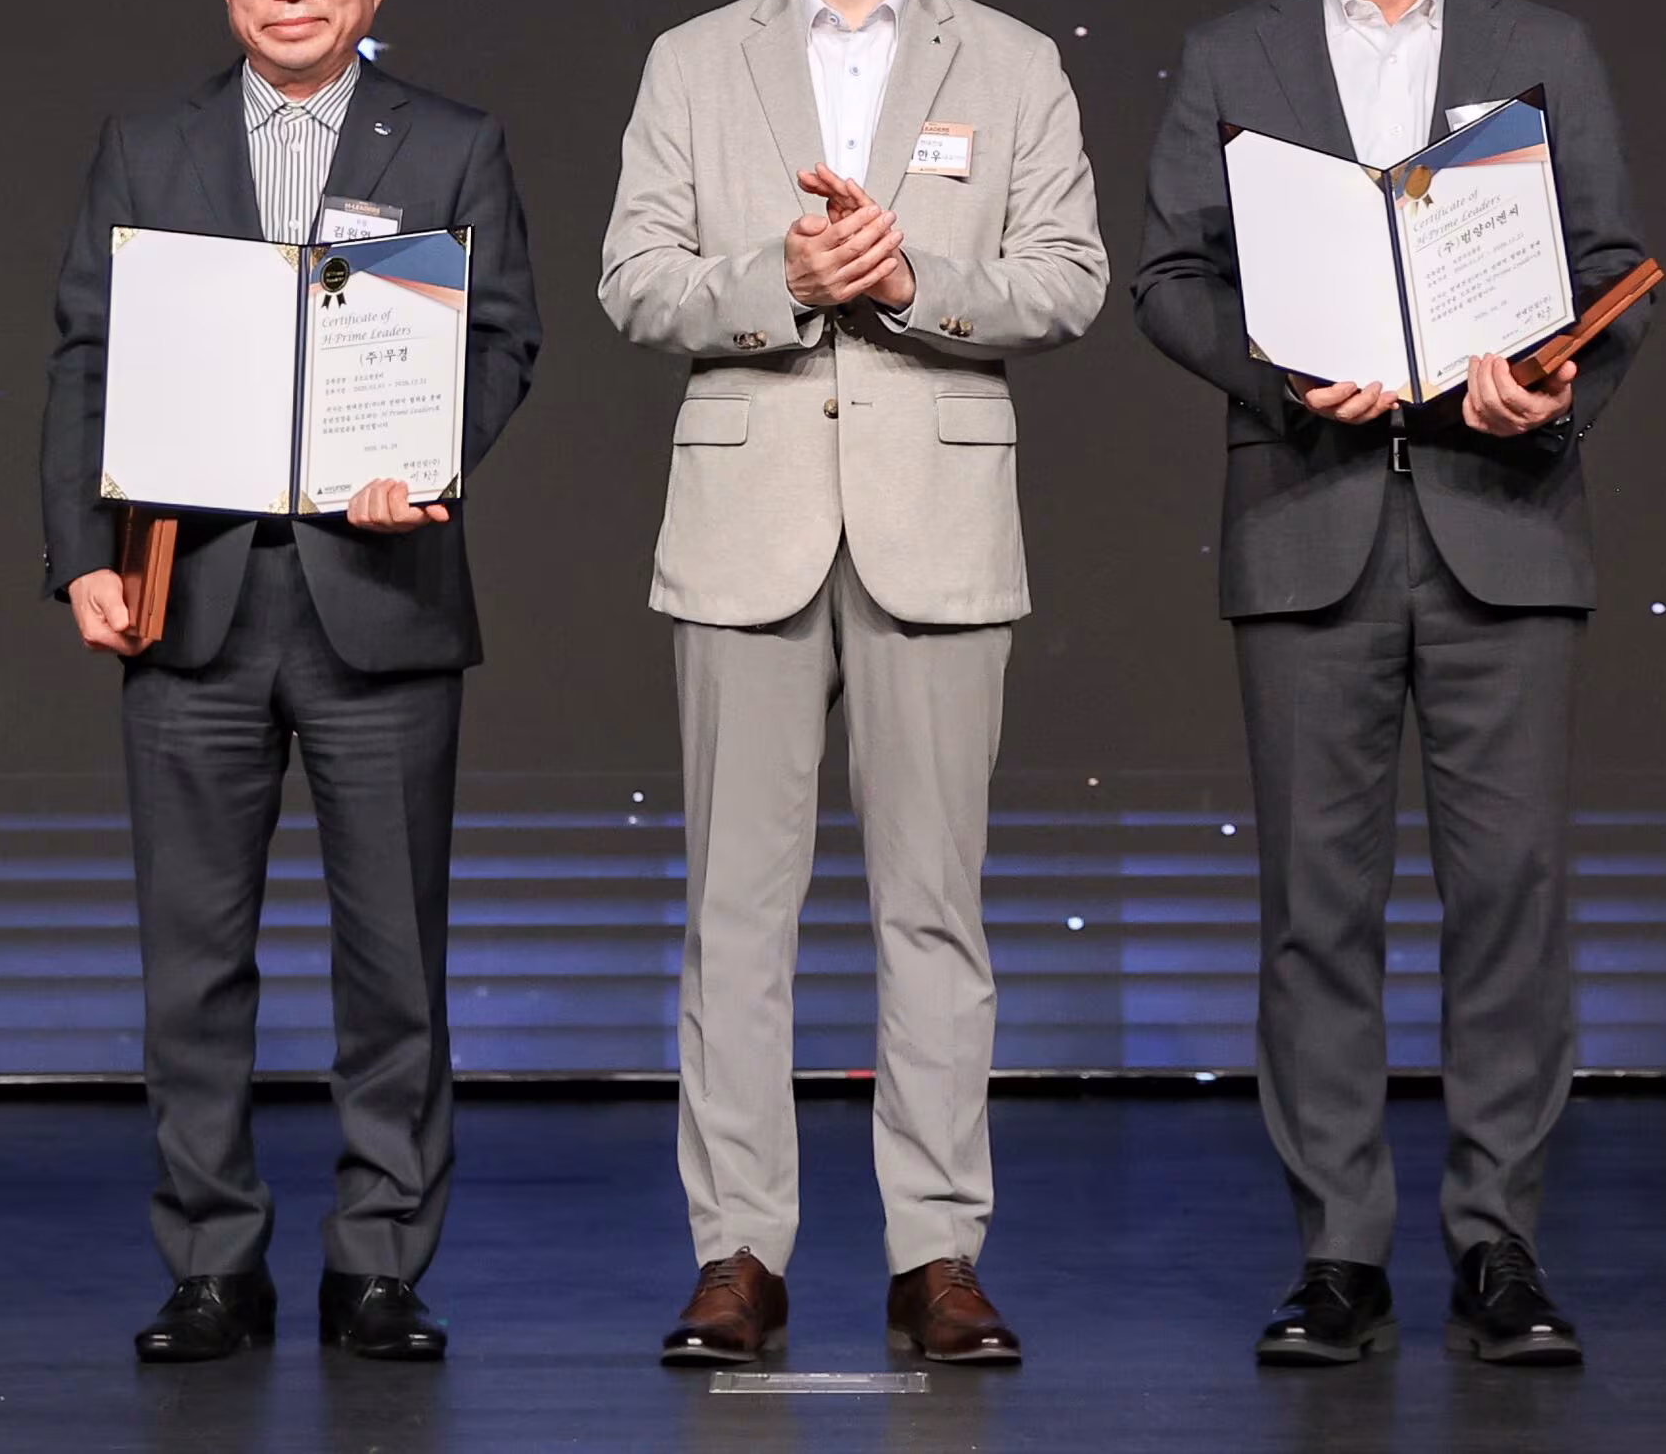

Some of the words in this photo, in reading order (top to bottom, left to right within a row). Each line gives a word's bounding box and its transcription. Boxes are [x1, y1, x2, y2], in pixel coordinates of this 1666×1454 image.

[321, 311, 378, 329] Certificate
[380, 307, 393, 323] of
[369, 325, 413, 339] Leaders
[359, 347, 409, 367] (주)무경
